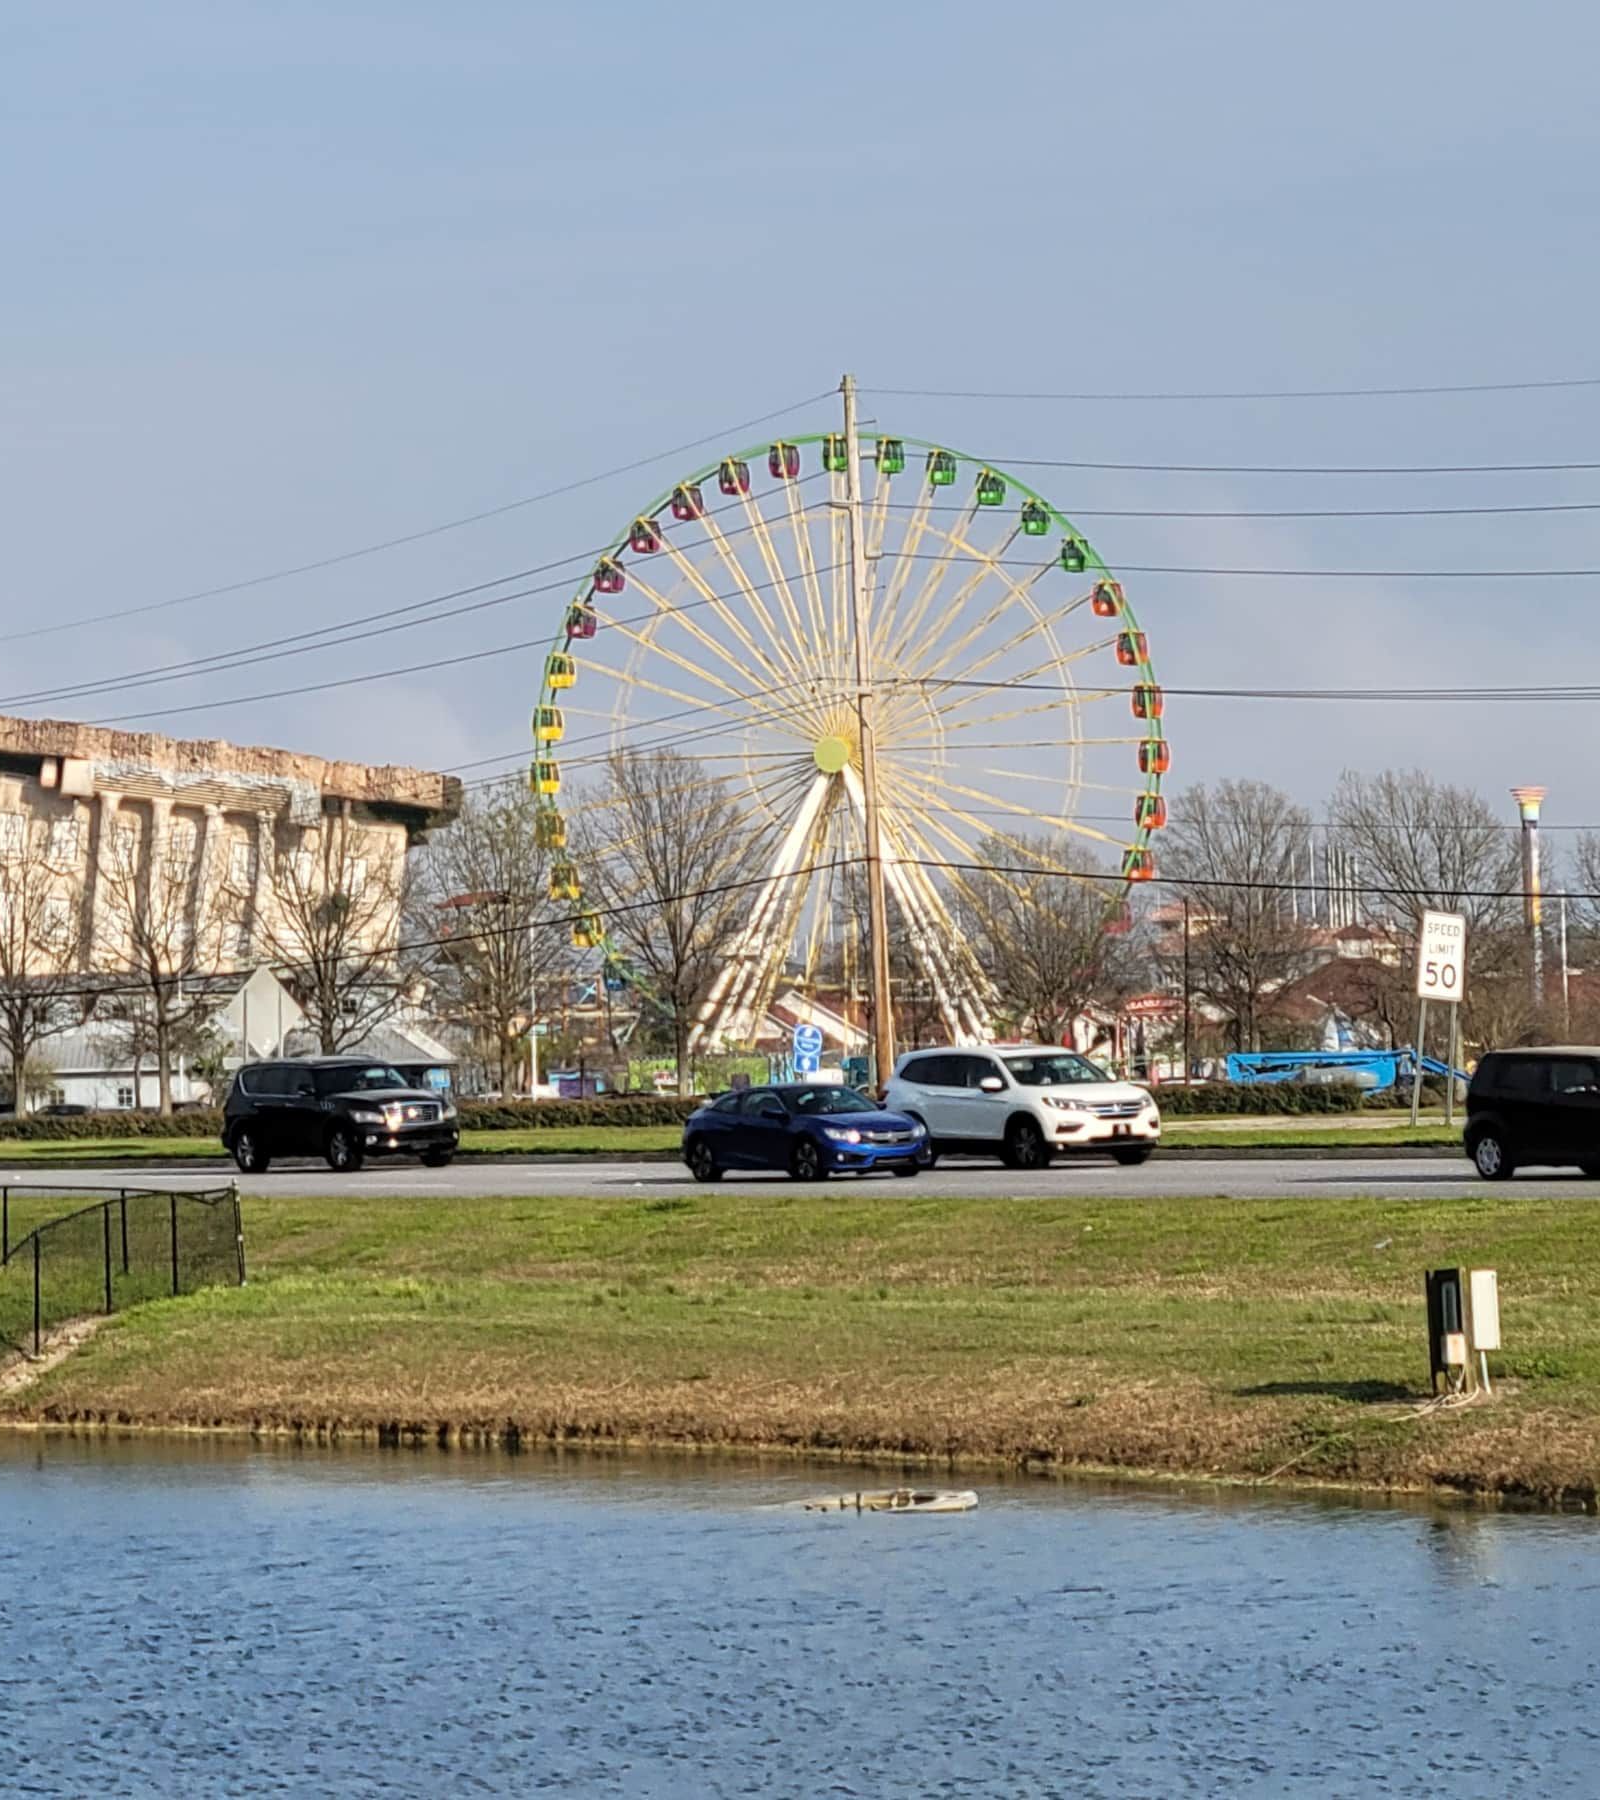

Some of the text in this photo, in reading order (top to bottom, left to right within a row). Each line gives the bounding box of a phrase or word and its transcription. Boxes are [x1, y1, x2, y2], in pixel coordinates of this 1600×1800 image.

[1427, 922, 1460, 937] SPEED
[1428, 943, 1456, 957] LIMIT
[1424, 960, 1457, 989] 50
